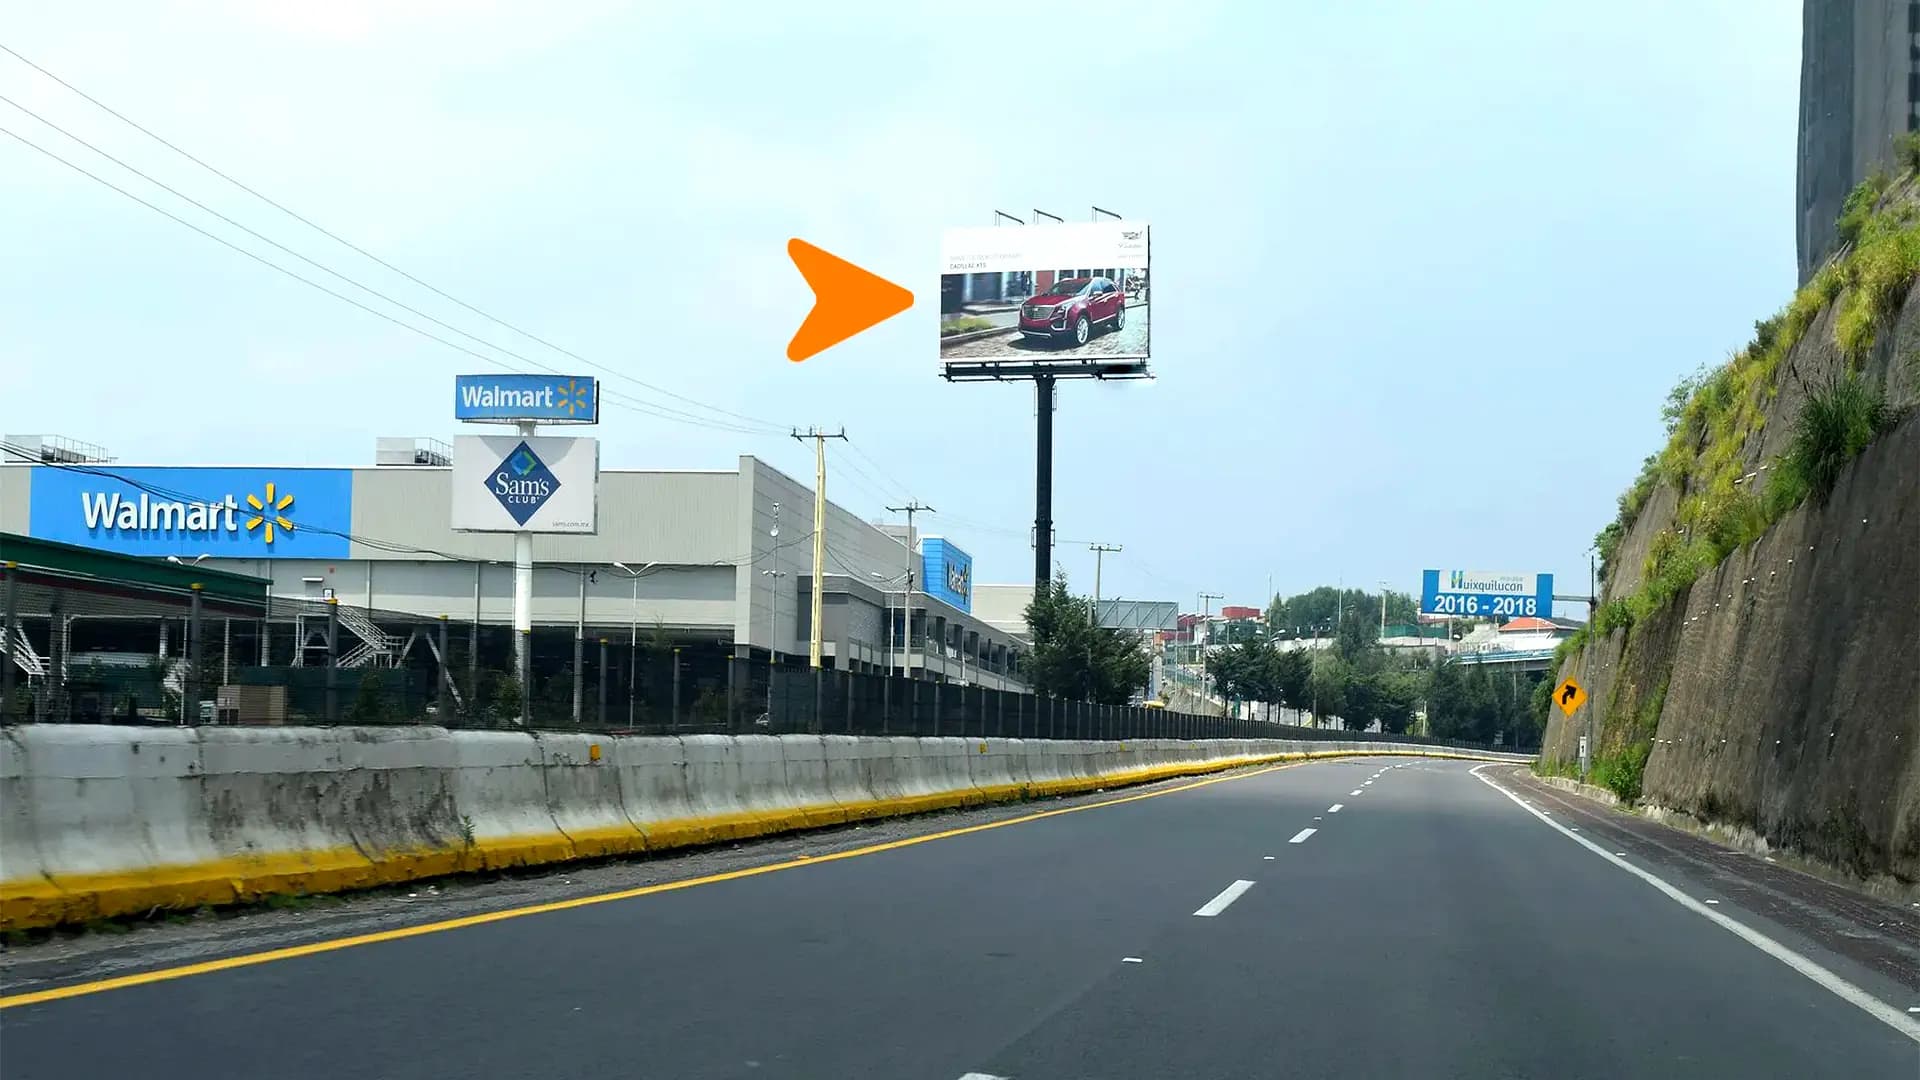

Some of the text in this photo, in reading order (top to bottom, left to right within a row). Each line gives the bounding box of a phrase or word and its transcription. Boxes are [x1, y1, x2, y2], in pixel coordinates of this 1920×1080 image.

[462, 385, 553, 408] Walmart
[495, 471, 550, 496] Sam's
[508, 495, 537, 504] CLUB
[81, 491, 238, 532] Walmart
[1451, 570, 1523, 592] Huixquilucan
[1434, 595, 1478, 613] 2016
[1493, 597, 1536, 616] 2018
